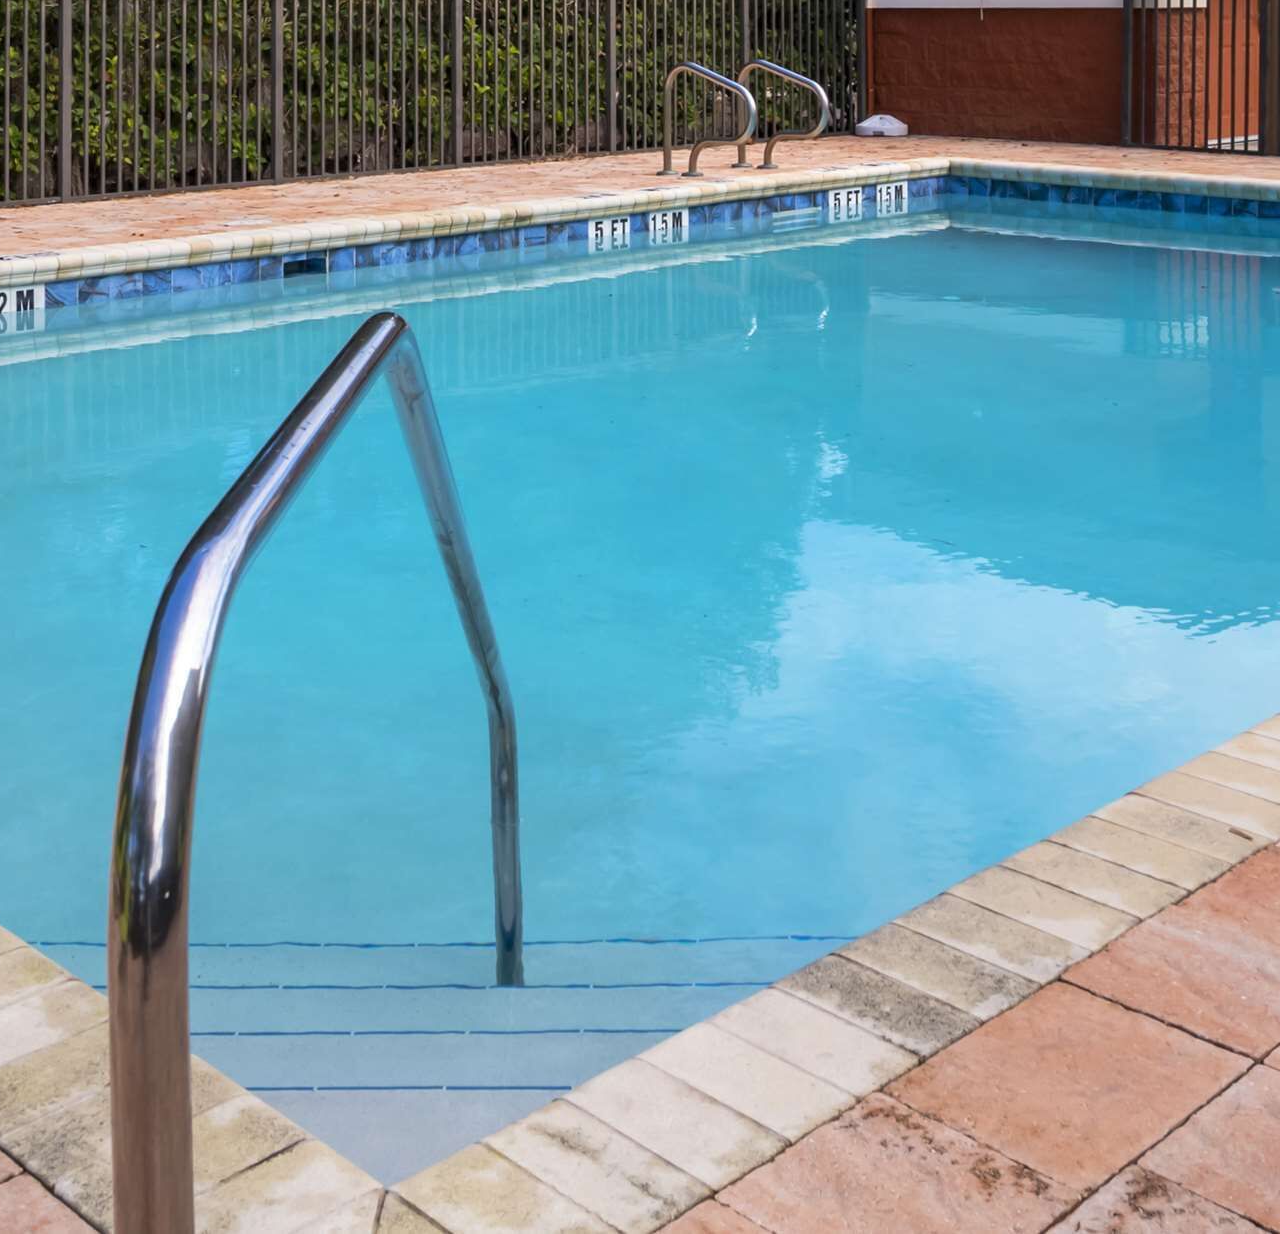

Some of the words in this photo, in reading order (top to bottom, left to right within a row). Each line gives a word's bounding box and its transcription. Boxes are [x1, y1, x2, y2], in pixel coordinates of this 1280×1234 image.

[834, 192, 840, 206] 5
[847, 190, 860, 206] FT
[595, 221, 603, 238] 5
[611, 218, 628, 237] FT
